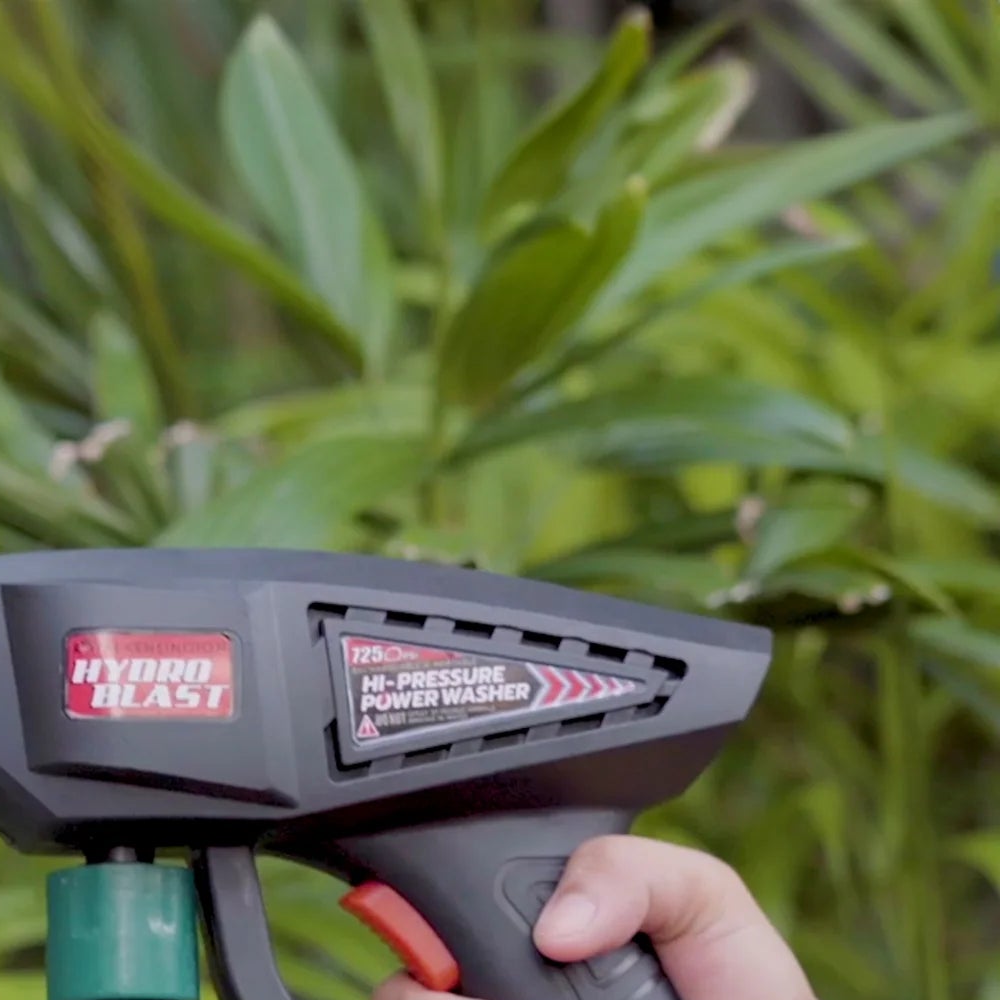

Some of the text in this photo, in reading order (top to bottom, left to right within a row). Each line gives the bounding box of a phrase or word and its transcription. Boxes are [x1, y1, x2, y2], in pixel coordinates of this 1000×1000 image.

[351, 645, 384, 665] 725
[72, 658, 213, 684] HYDRO
[91, 684, 230, 708] BLAST
[360, 682, 532, 713] POWER WASHER
